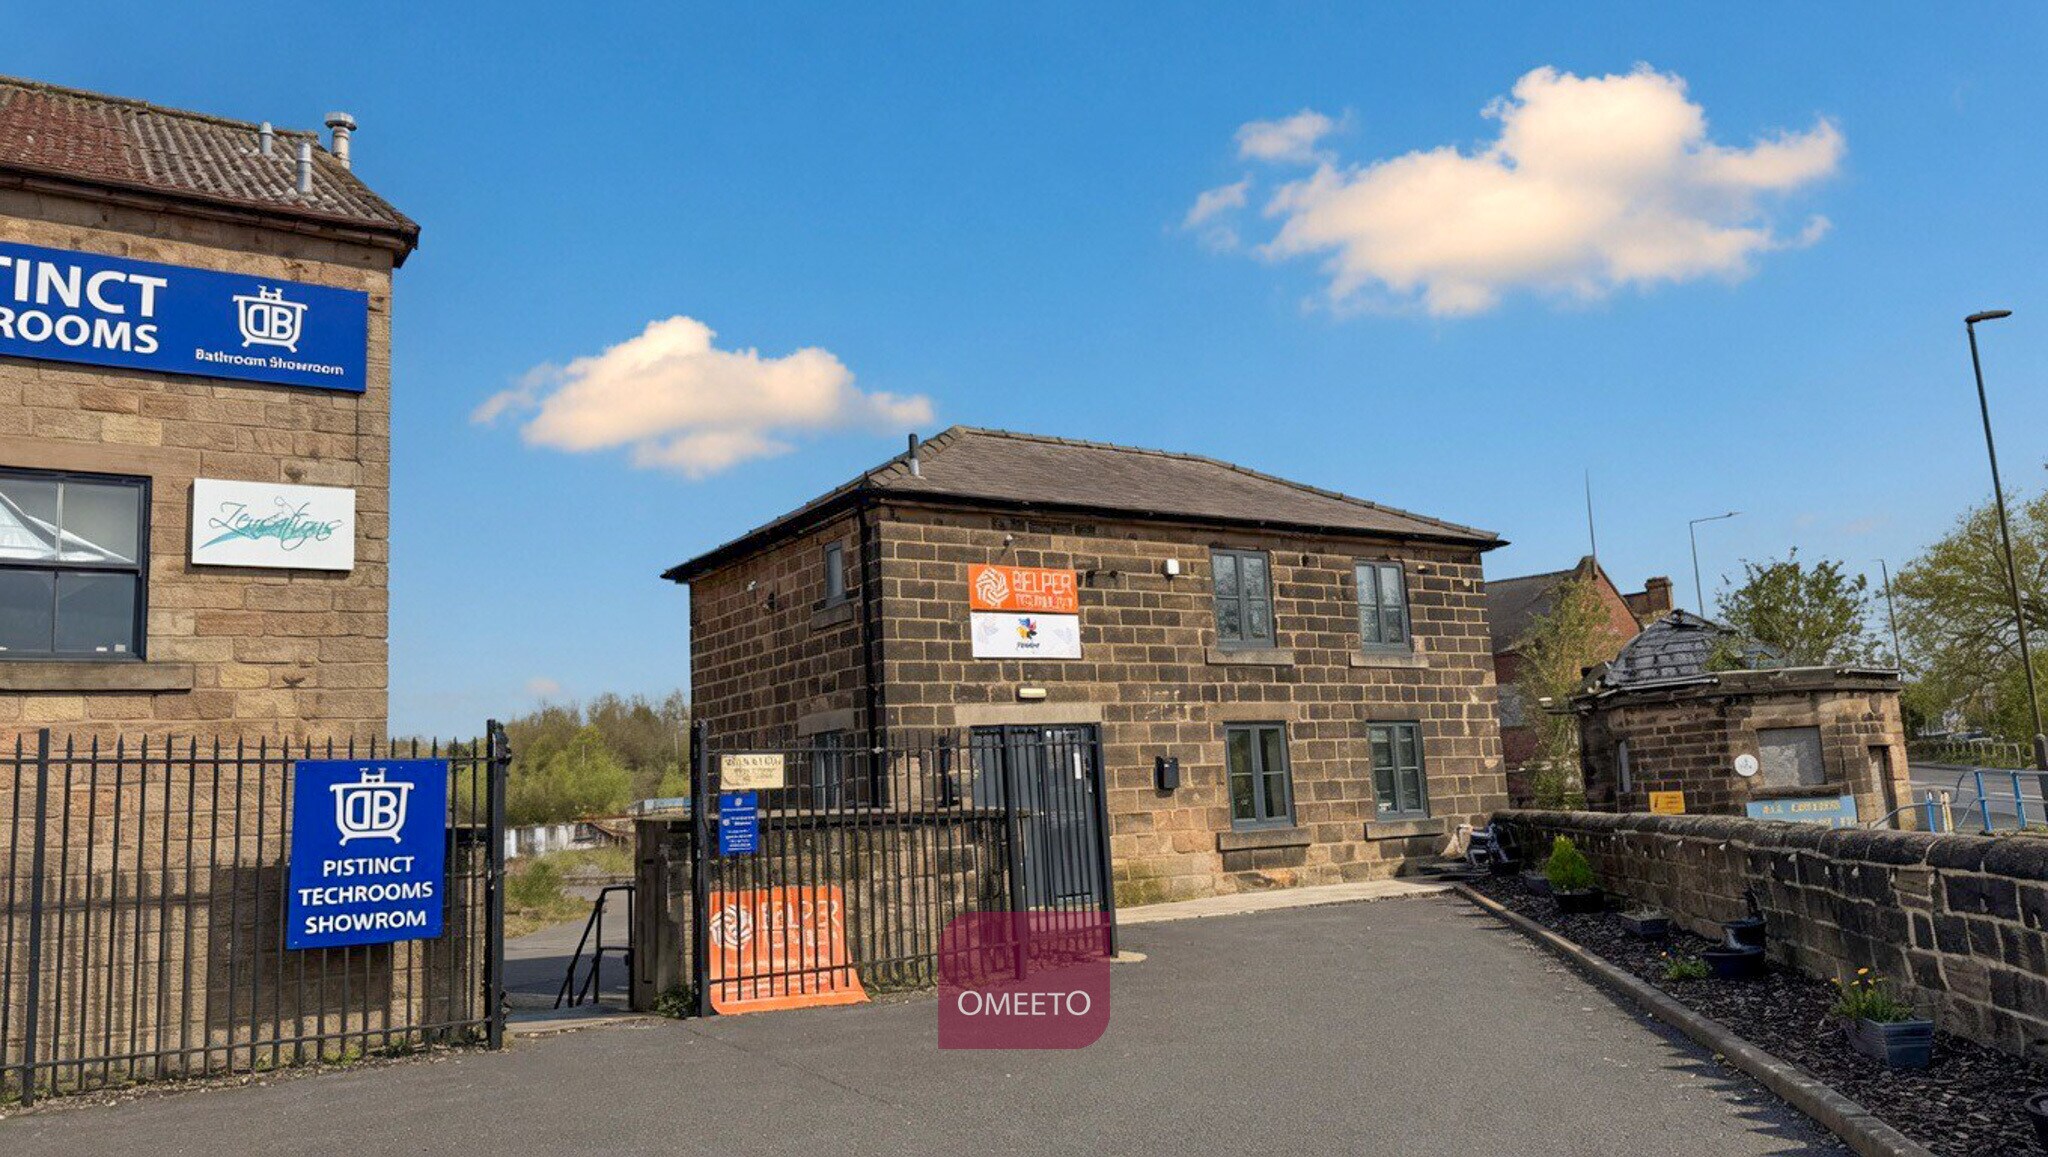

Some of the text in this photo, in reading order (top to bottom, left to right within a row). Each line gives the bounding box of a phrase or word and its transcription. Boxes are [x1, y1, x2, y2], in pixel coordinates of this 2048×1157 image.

[195, 348, 345, 376] Bathroom Showroom
[1012, 570, 1074, 597] BELPER
[323, 856, 415, 877] PISTINCT
[298, 881, 434, 906] TECHROOMS
[305, 910, 427, 934] SHOWROM
